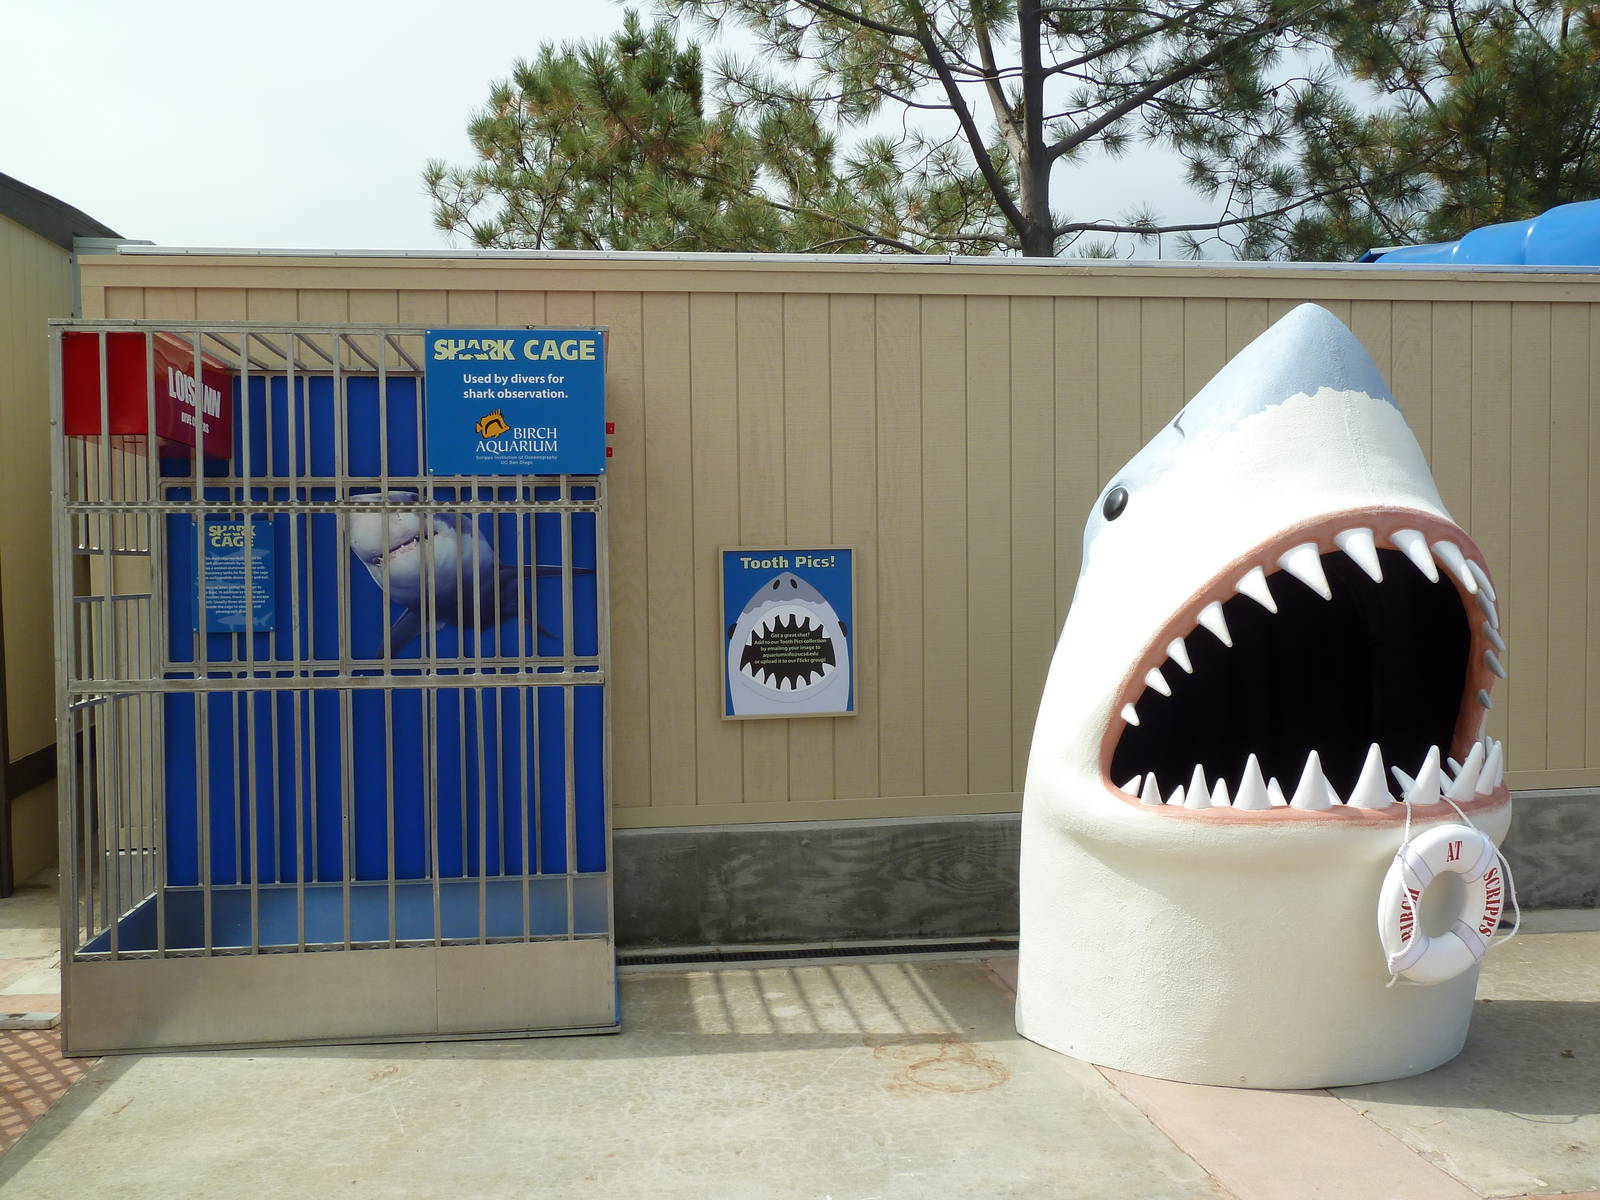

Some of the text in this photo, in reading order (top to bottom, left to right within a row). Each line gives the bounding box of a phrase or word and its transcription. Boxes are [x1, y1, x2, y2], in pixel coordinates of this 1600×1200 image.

[434, 338, 596, 361] SHARK CAGE
[463, 373, 565, 386] Used by divers for
[463, 388, 569, 399] shark observation.
[513, 427, 557, 439] BIRCH
[476, 440, 558, 454] AQUARIUM
[740, 556, 835, 569] Tooth Pics!
[1446, 841, 1463, 862] AT
[1478, 867, 1500, 938] SCRIPPS
